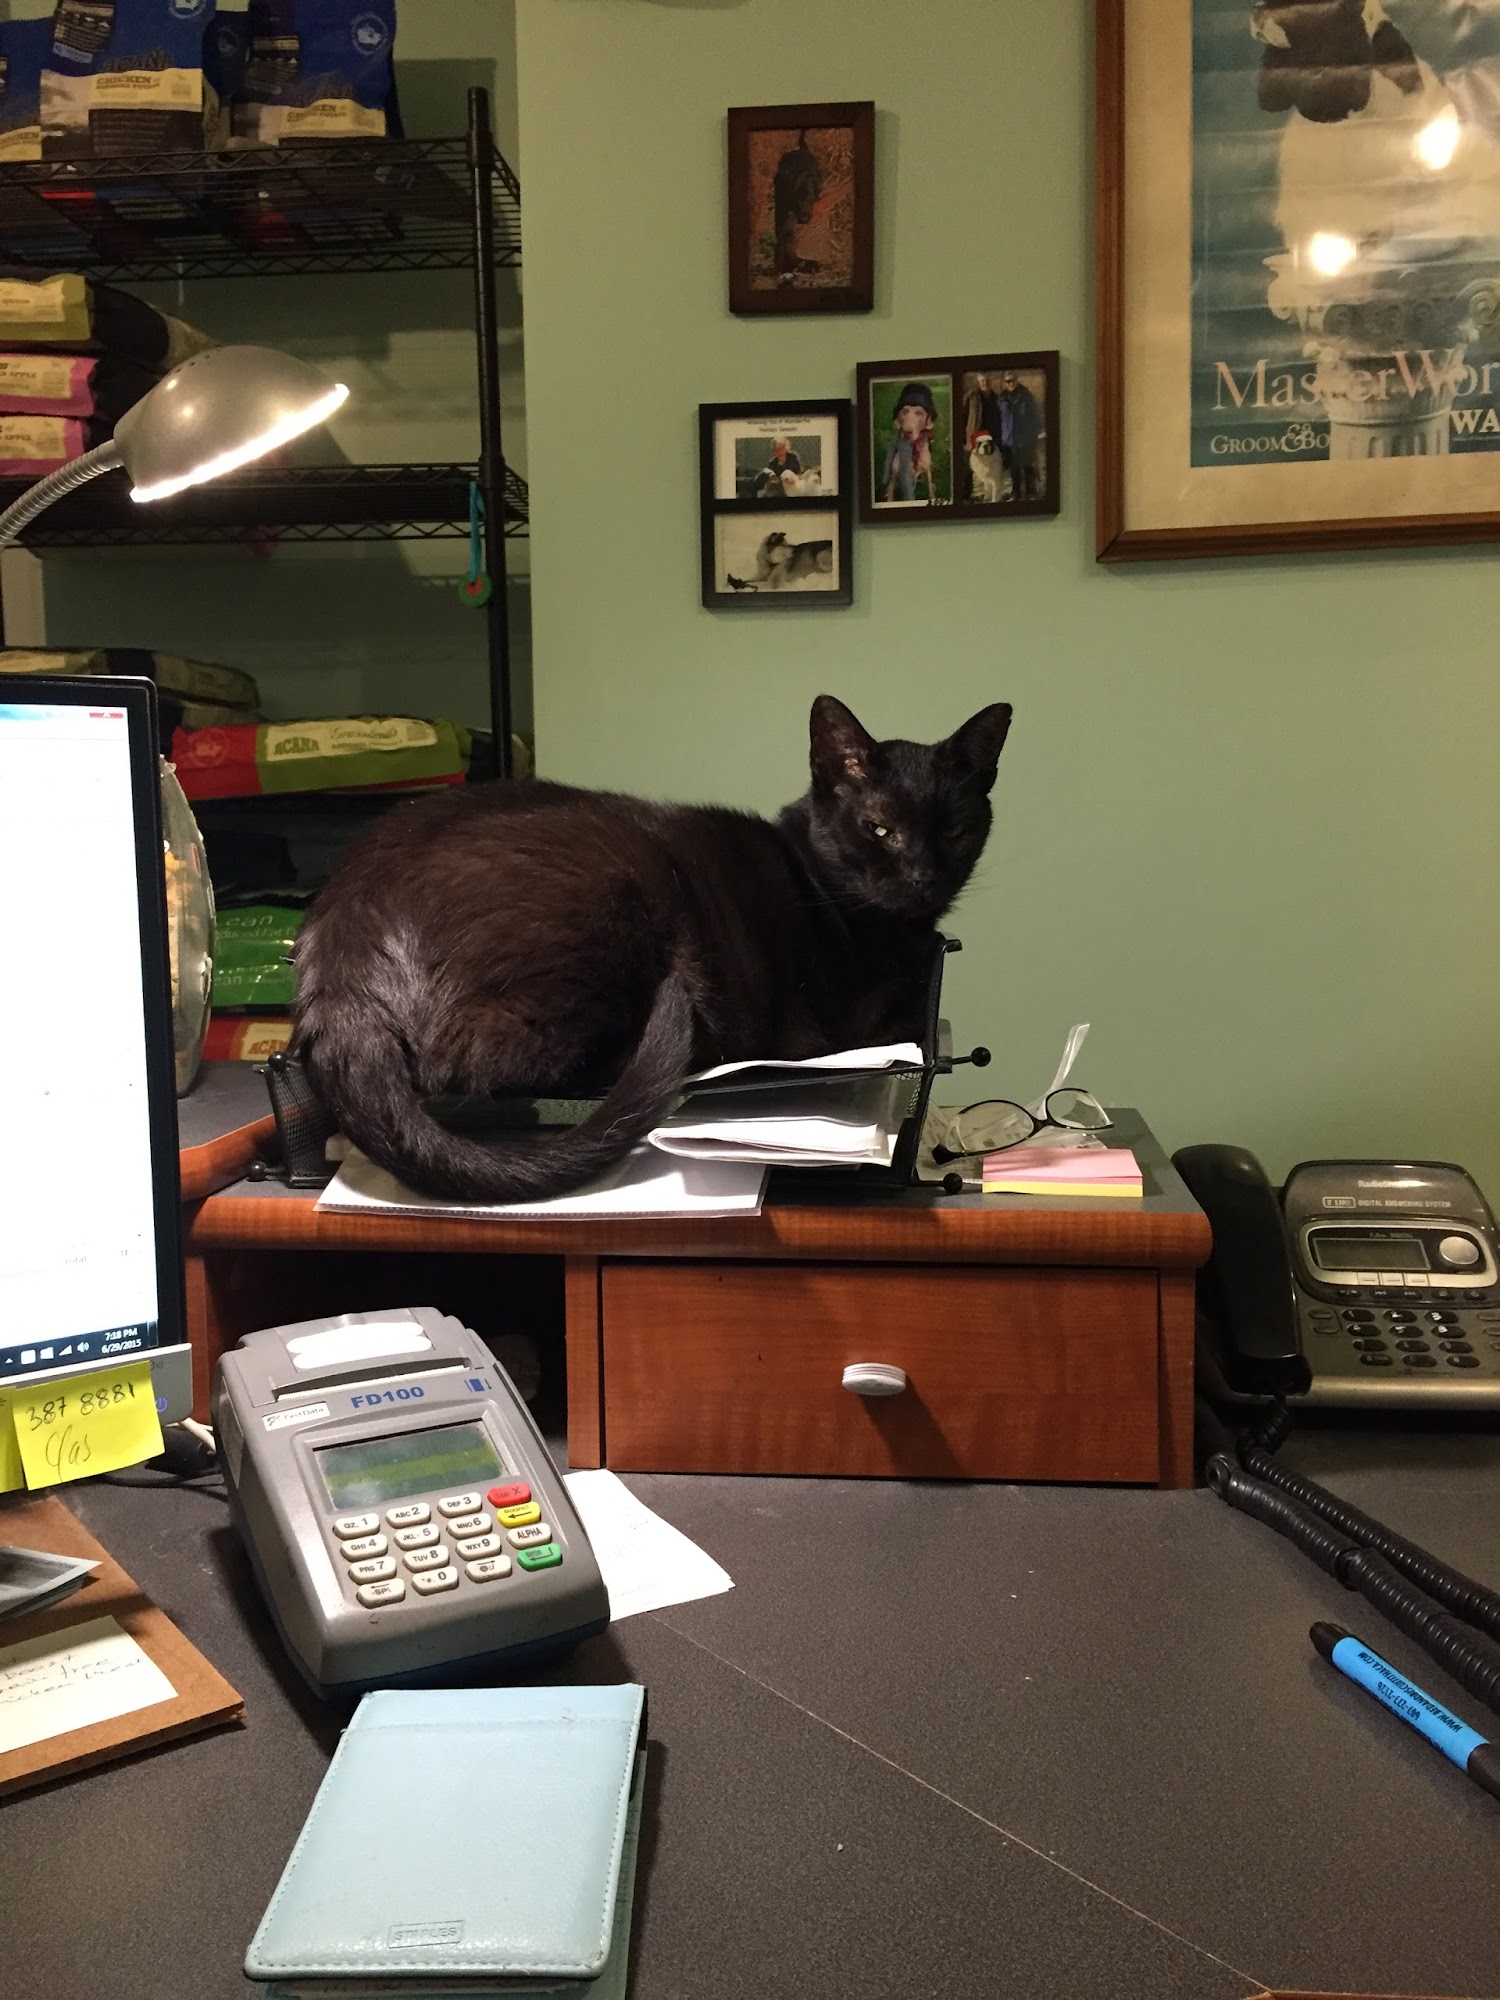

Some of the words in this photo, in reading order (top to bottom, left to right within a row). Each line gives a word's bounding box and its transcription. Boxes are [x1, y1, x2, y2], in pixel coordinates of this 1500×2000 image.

[1211, 348, 1500, 411] MaserWor
[274, 736, 320, 755] ACANA
[224, 915, 273, 927] ean
[1358, 1199, 1383, 1207] DIGITAL
[1425, 1200, 1451, 1208] SYSTEM
[105, 1331, 122, 1341] 7:18
[123, 1328, 138, 1338] PM
[101, 1338, 142, 1354] 6/29/2015
[351, 1386, 425, 1409] FD100
[26, 1396, 67, 1431] 387
[463, 1497, 472, 1505] 3
[411, 1507, 421, 1516] 2
[361, 1517, 369, 1526] 1
[473, 1517, 482, 1526] 6
[422, 1527, 431, 1536] 5
[517, 1527, 543, 1539] ALPHA
[368, 1538, 377, 1547] 4
[481, 1538, 491, 1547] 9
[412, 1554, 428, 1562] TUV
[429, 1549, 439, 1559] 8
[359, 1565, 376, 1573] PRS
[376, 1560, 385, 1569] 7
[437, 1571, 447, 1581] 0
[394, 1926, 457, 1941] STAPLES
